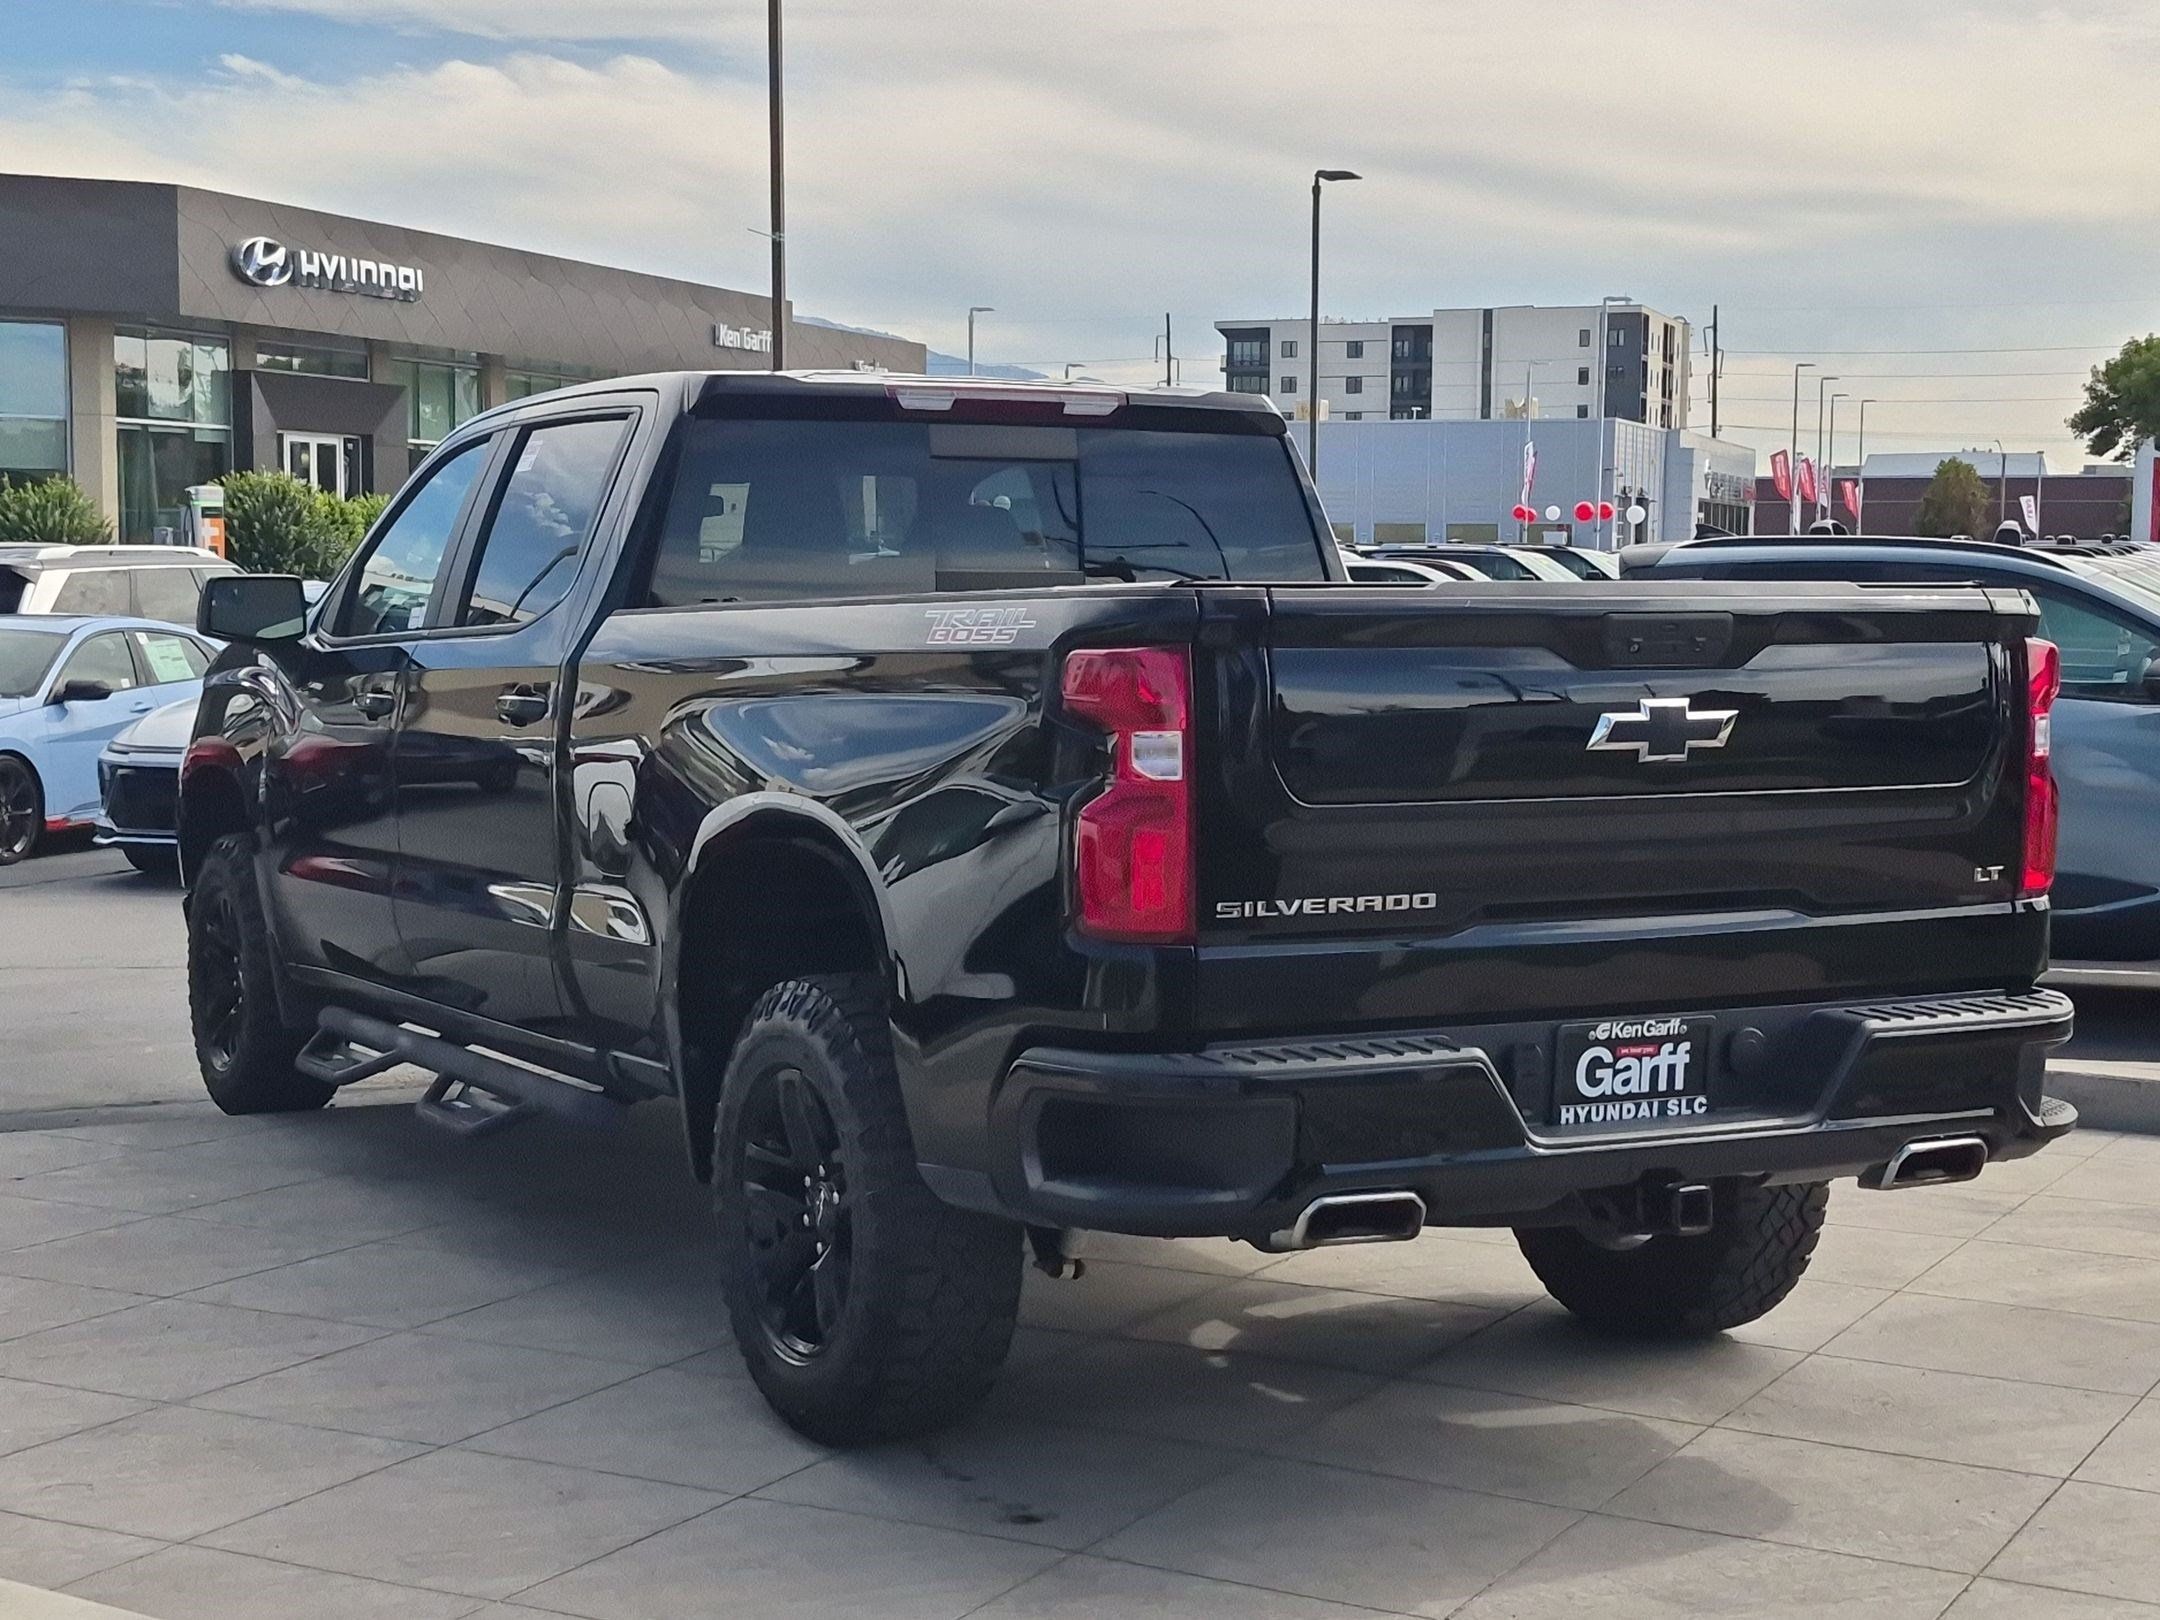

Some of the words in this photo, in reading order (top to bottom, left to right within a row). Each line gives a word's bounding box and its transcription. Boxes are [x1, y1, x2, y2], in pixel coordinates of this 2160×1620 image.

[300, 250, 424, 292] HYUNDAI
[719, 323, 741, 348] Ken
[741, 327, 773, 353] Garff
[925, 607, 1037, 628] TRAIL
[925, 627, 1019, 645] BOSS
[1973, 865, 2005, 883] LT
[1215, 892, 1437, 919] SILVERADO
[1611, 1022, 1642, 1040] Ken
[1642, 1018, 1682, 1037] Garff
[1575, 1041, 1692, 1098] Garff
[1560, 1100, 1659, 1125] HYUNDAI
[1666, 1096, 1708, 1117] SLC
